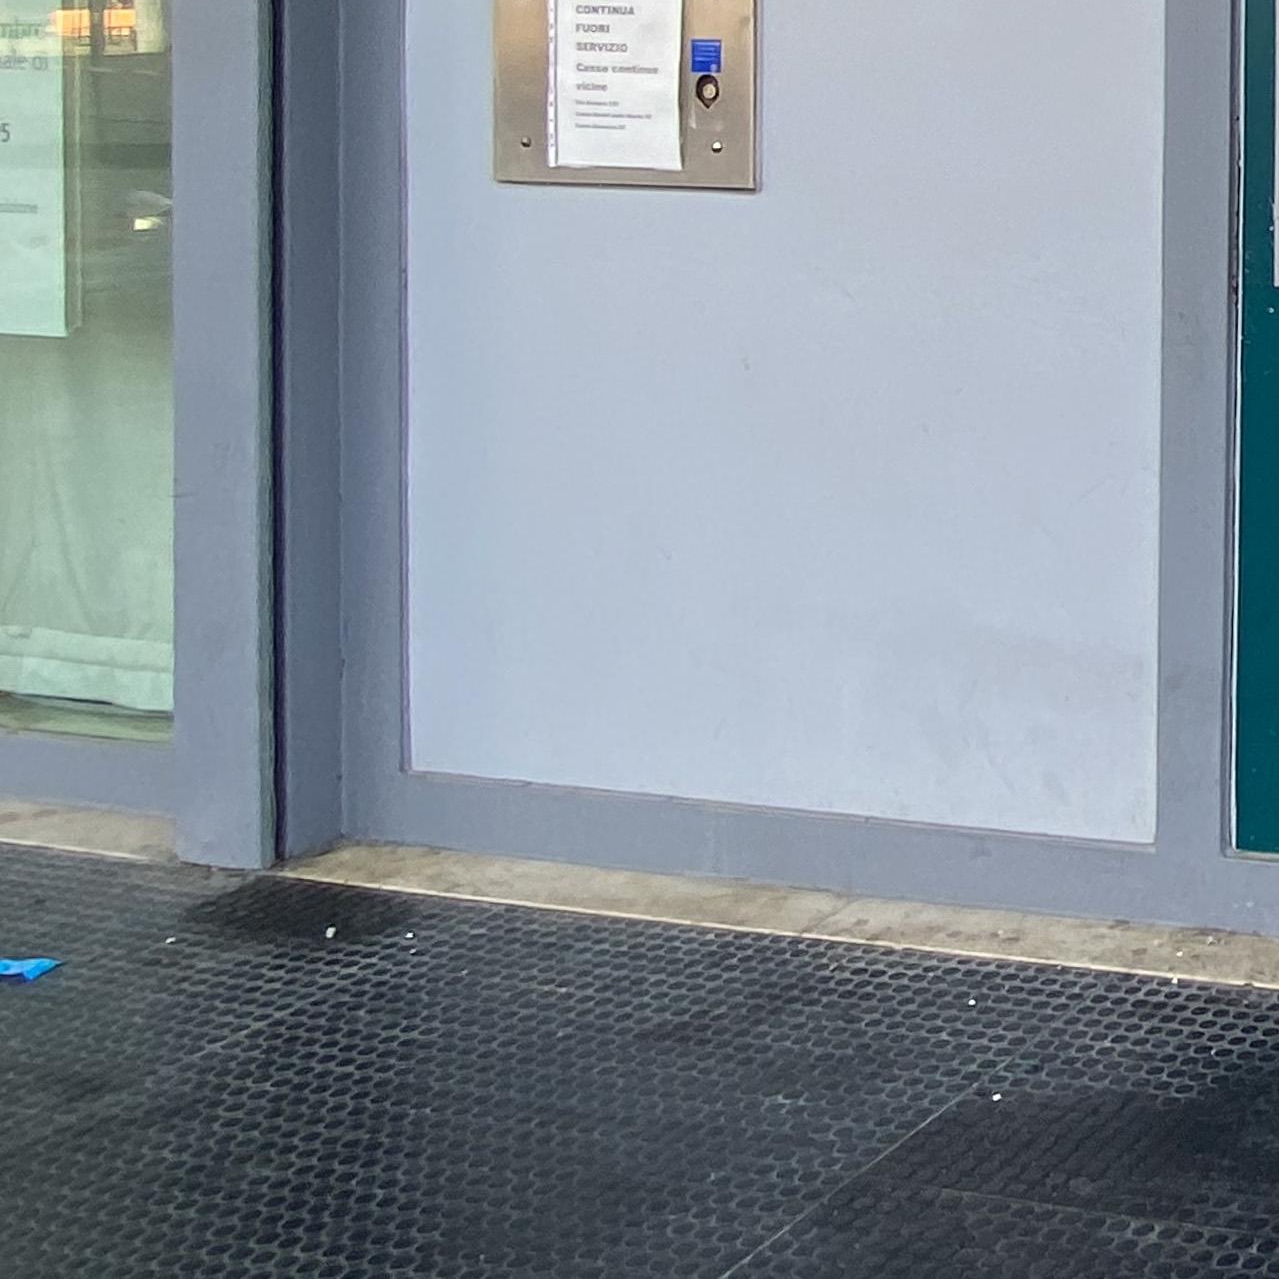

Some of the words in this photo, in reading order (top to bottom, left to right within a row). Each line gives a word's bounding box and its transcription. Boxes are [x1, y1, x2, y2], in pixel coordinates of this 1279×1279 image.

[576, 5, 636, 16] CONTINUA
[576, 24, 610, 34] FUORI
[576, 42, 628, 53] SERVIZIO
